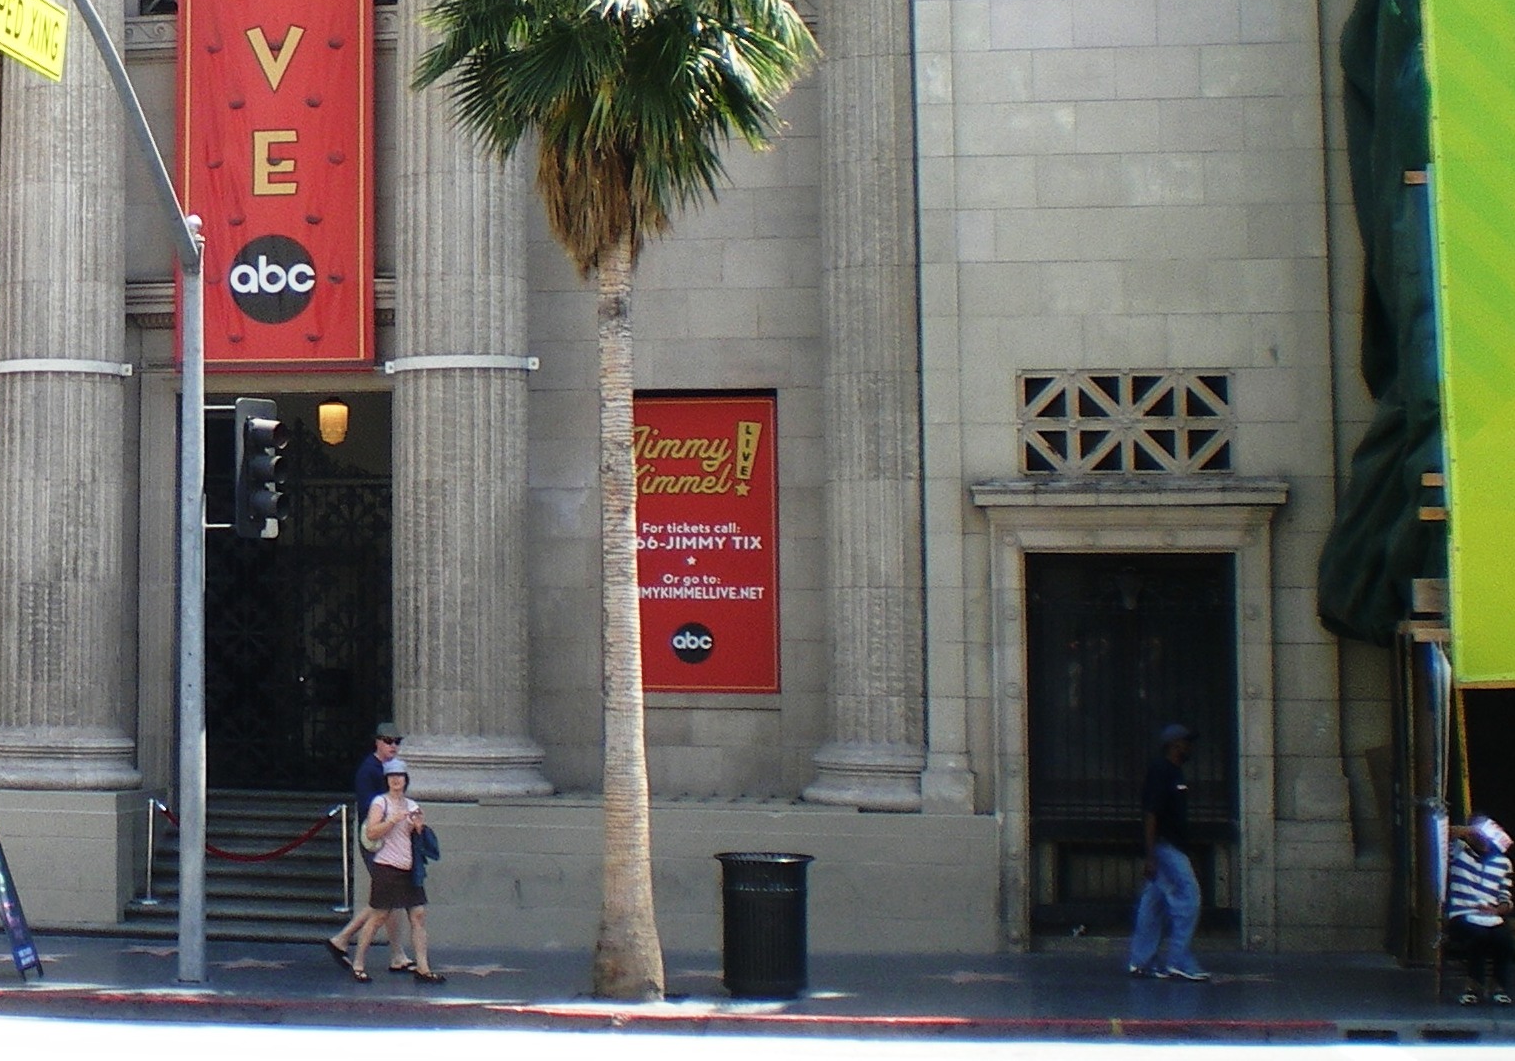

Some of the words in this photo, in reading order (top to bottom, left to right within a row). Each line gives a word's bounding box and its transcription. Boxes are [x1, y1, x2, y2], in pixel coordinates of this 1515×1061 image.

[27, 6, 60, 61] XING
[229, 255, 316, 295] abc
[740, 424, 753, 477] LIVE
[642, 522, 664, 534] For
[666, 522, 711, 534] tickets
[713, 522, 742, 534] call:
[636, 536, 727, 550] 66-JIMMY
[731, 536, 763, 550] TIX
[662, 573, 680, 585] Or
[682, 576, 700, 587] go
[702, 574, 721, 585] to:
[638, 586, 765, 600] MYKIMMELLIVE.NET
[672, 630, 714, 650] abc
